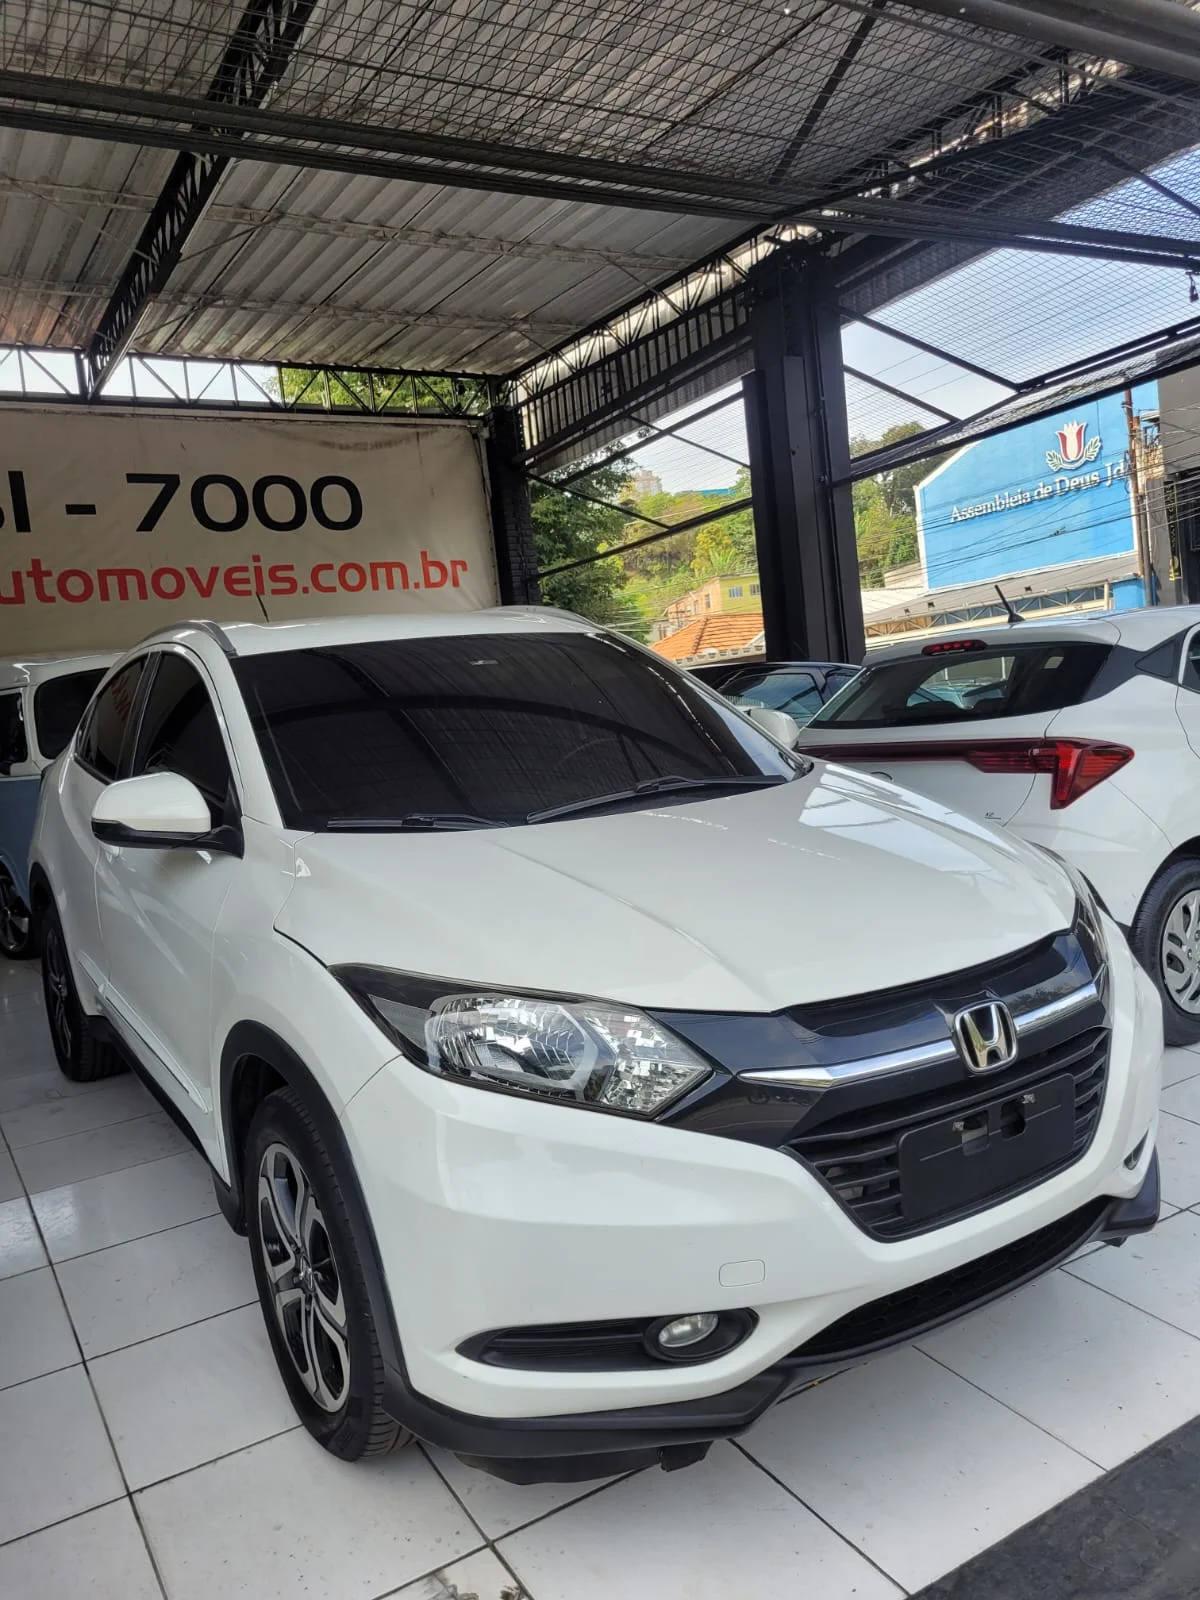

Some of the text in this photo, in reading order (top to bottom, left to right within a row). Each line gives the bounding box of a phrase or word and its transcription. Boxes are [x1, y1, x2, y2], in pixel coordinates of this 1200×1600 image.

[126, 473, 363, 533] 7000
[951, 487, 1031, 523] Assembleia
[1034, 481, 1053, 500] de
[1055, 472, 1100, 496] Deus
